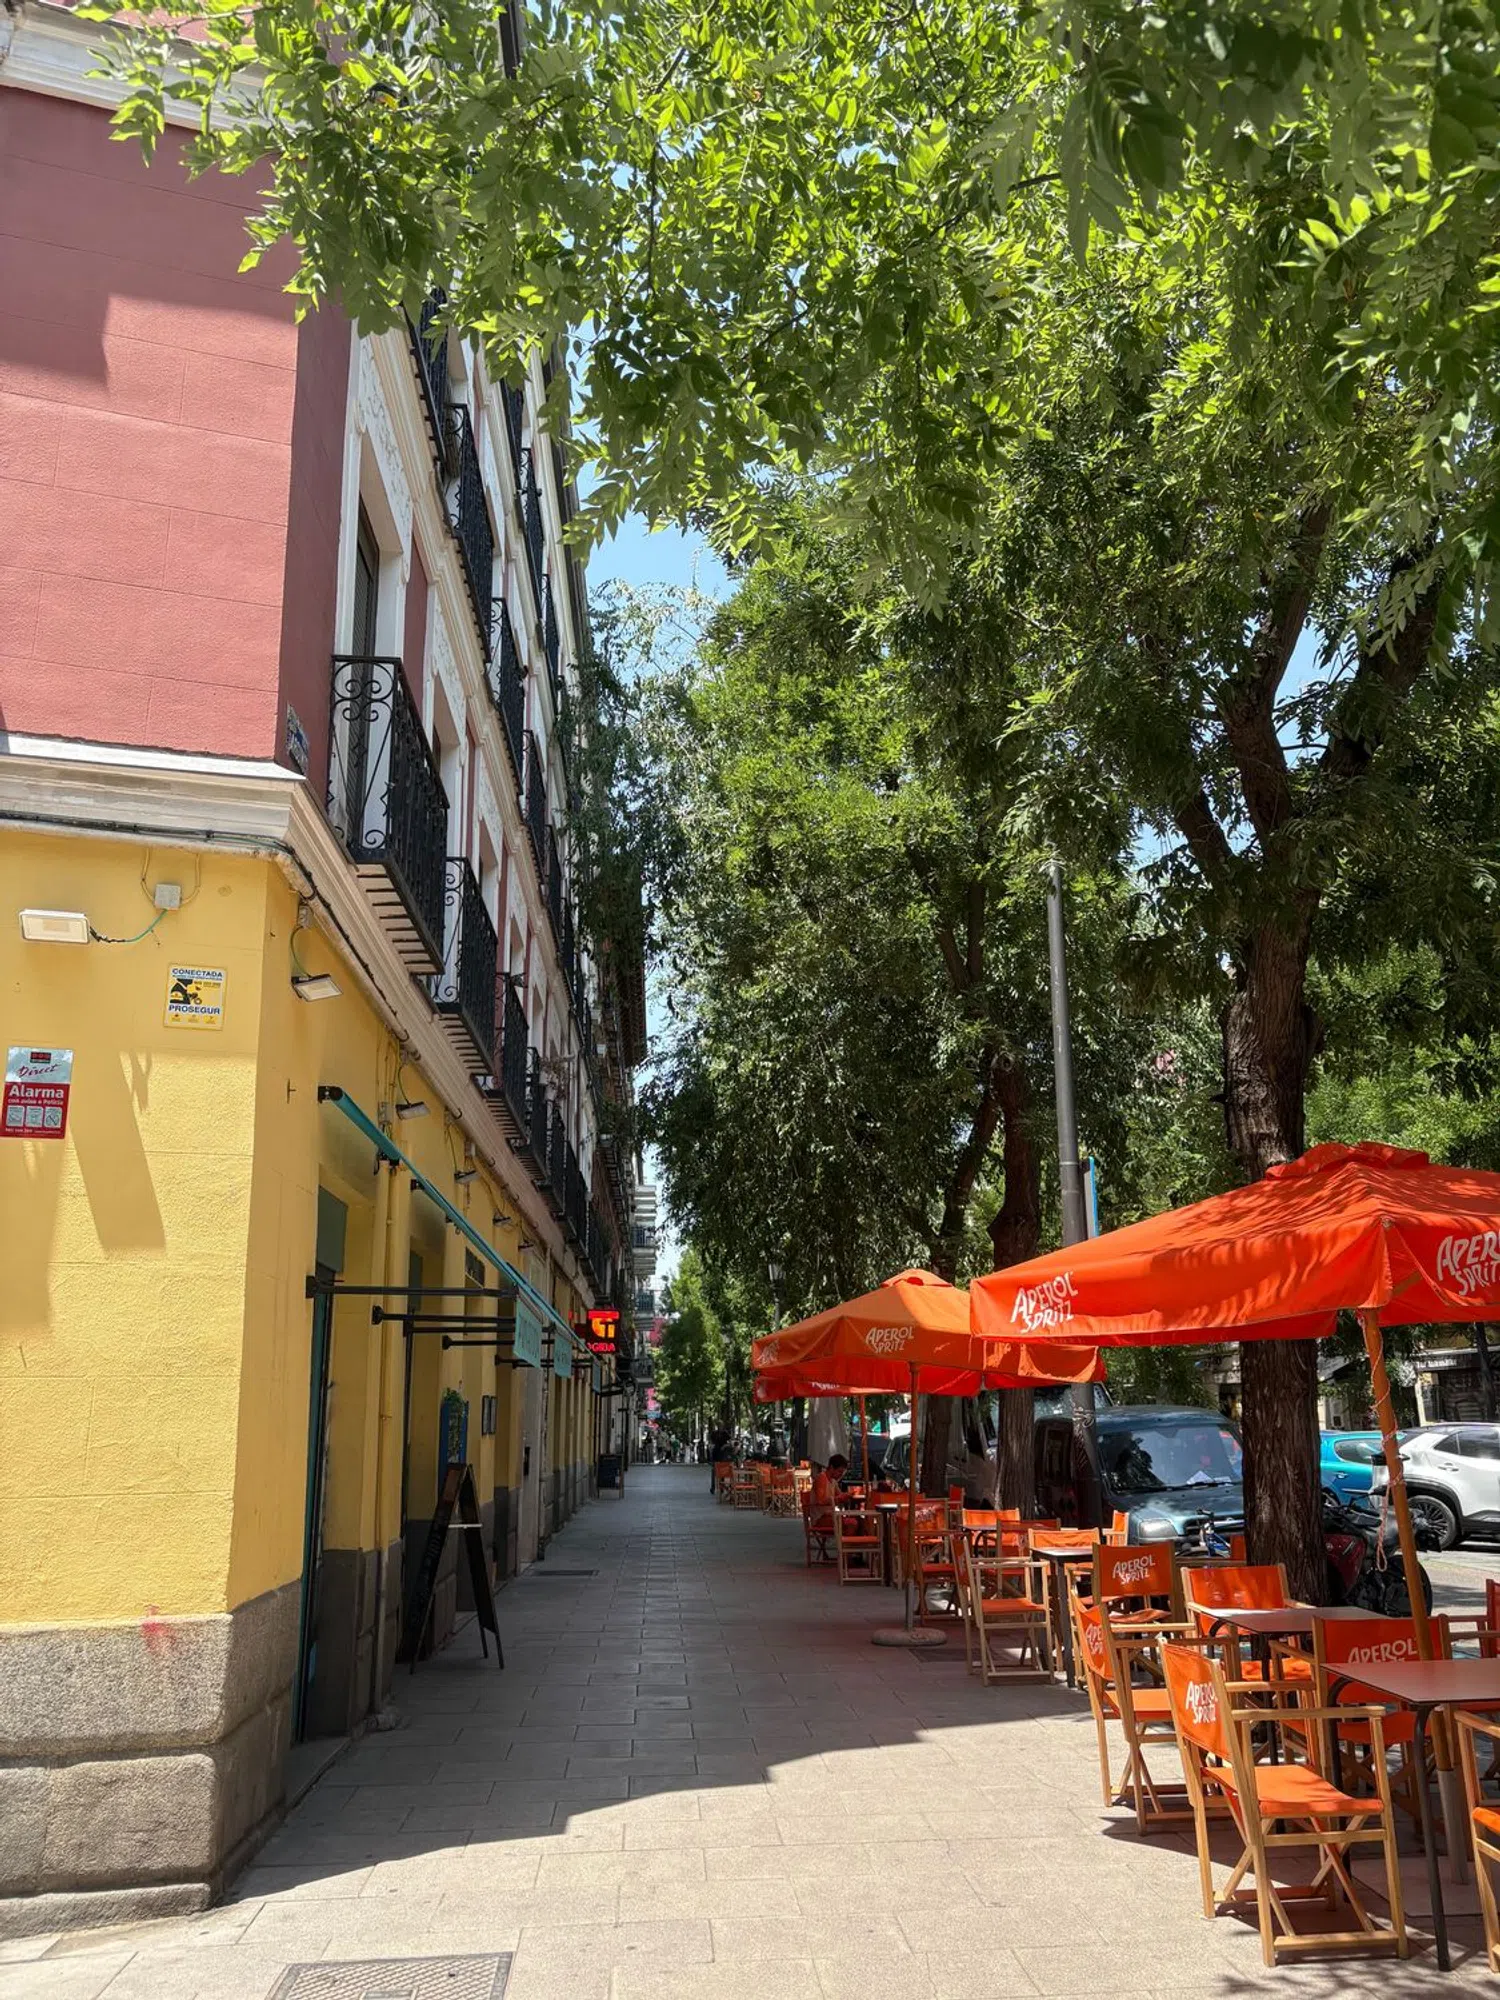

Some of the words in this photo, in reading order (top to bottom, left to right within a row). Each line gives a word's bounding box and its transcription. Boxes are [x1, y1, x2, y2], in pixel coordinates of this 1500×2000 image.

[171, 968, 223, 977] CONECTADA
[168, 1004, 220, 1015] PROSEGUR
[17, 1063, 61, 1078] Direct
[9, 1085, 64, 1098] Alarma
[1437, 1231, 1500, 1281] APER
[1010, 1271, 1079, 1323] APEROL
[865, 1326, 915, 1345] APEROL
[1112, 1554, 1156, 1579] APEROL
